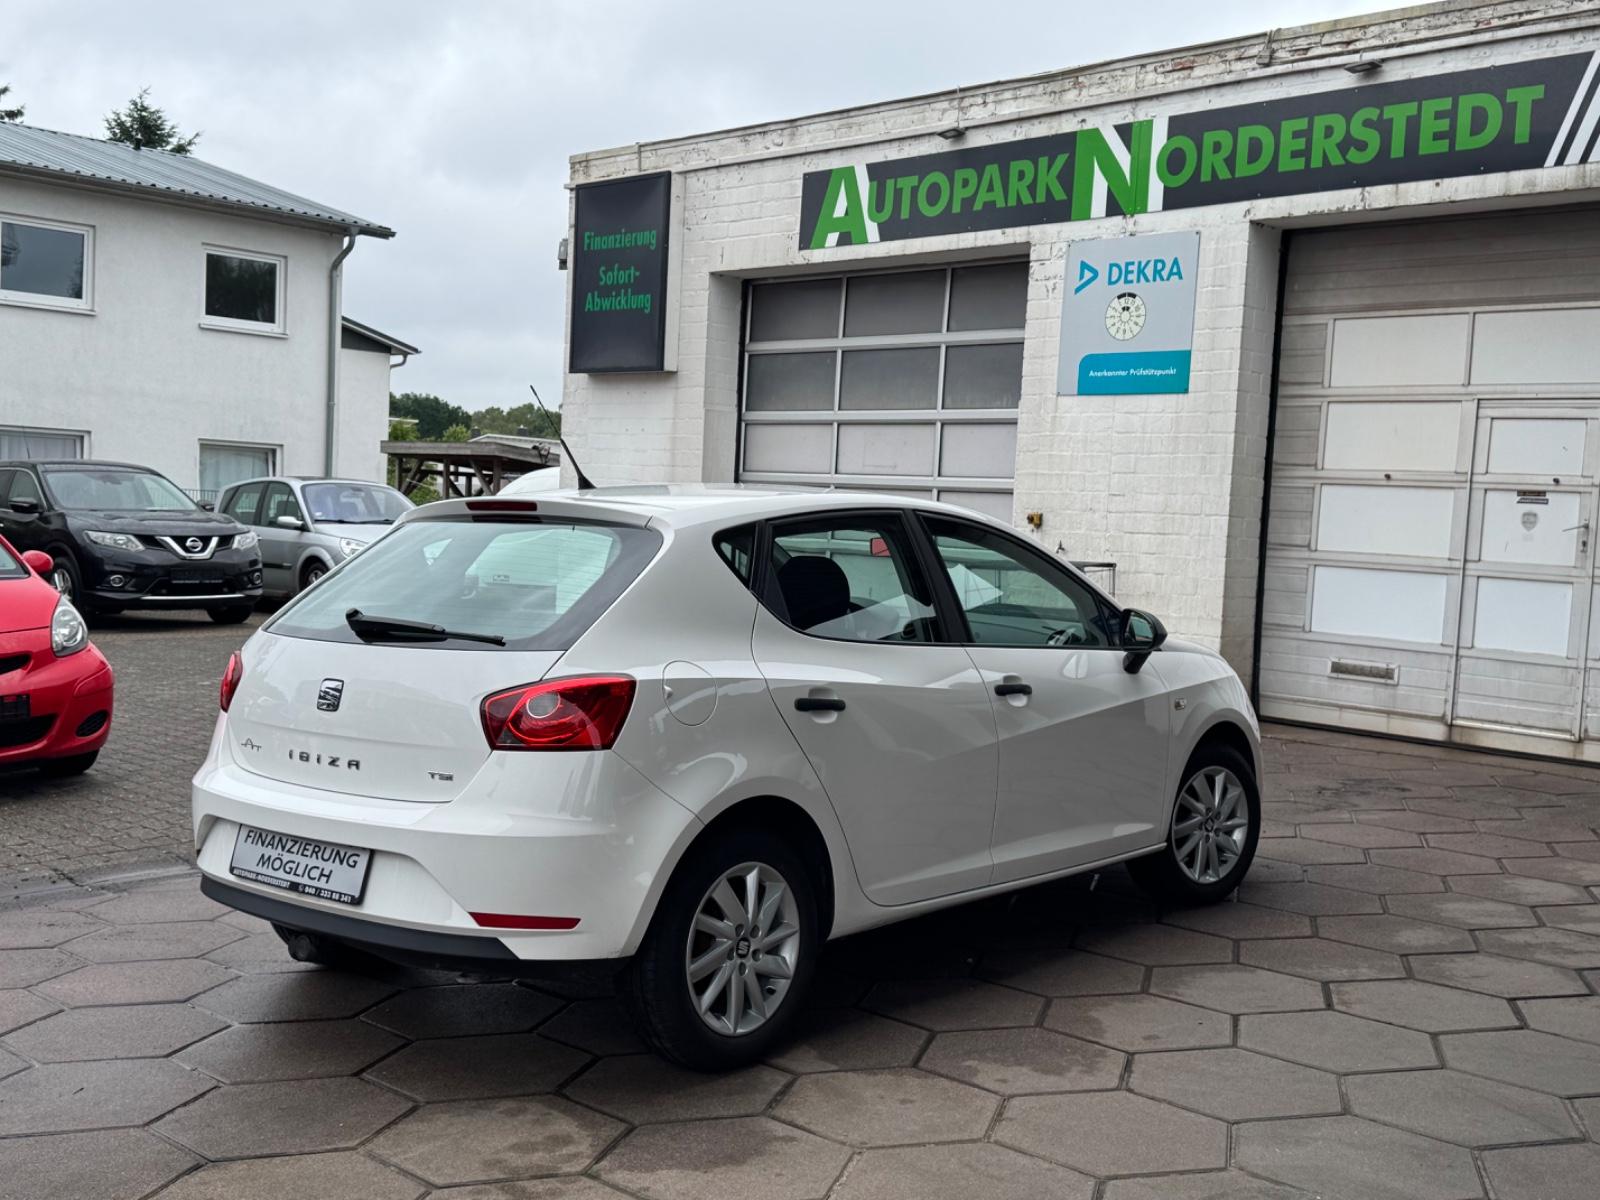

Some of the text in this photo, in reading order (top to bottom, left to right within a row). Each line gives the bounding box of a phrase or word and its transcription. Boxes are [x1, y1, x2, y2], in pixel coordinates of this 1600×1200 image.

[810, 84, 1545, 249] AUTOPARK NORDERSTEDT
[584, 229, 657, 251] Finanzierung
[599, 264, 641, 286] Sofort-
[1107, 256, 1184, 286] DEKRA
[585, 288, 652, 314] Abwicklung
[288, 749, 361, 771] IBIZA
[244, 829, 361, 869] FINANZIERUNG
[256, 852, 333, 884] MÖGLICH
